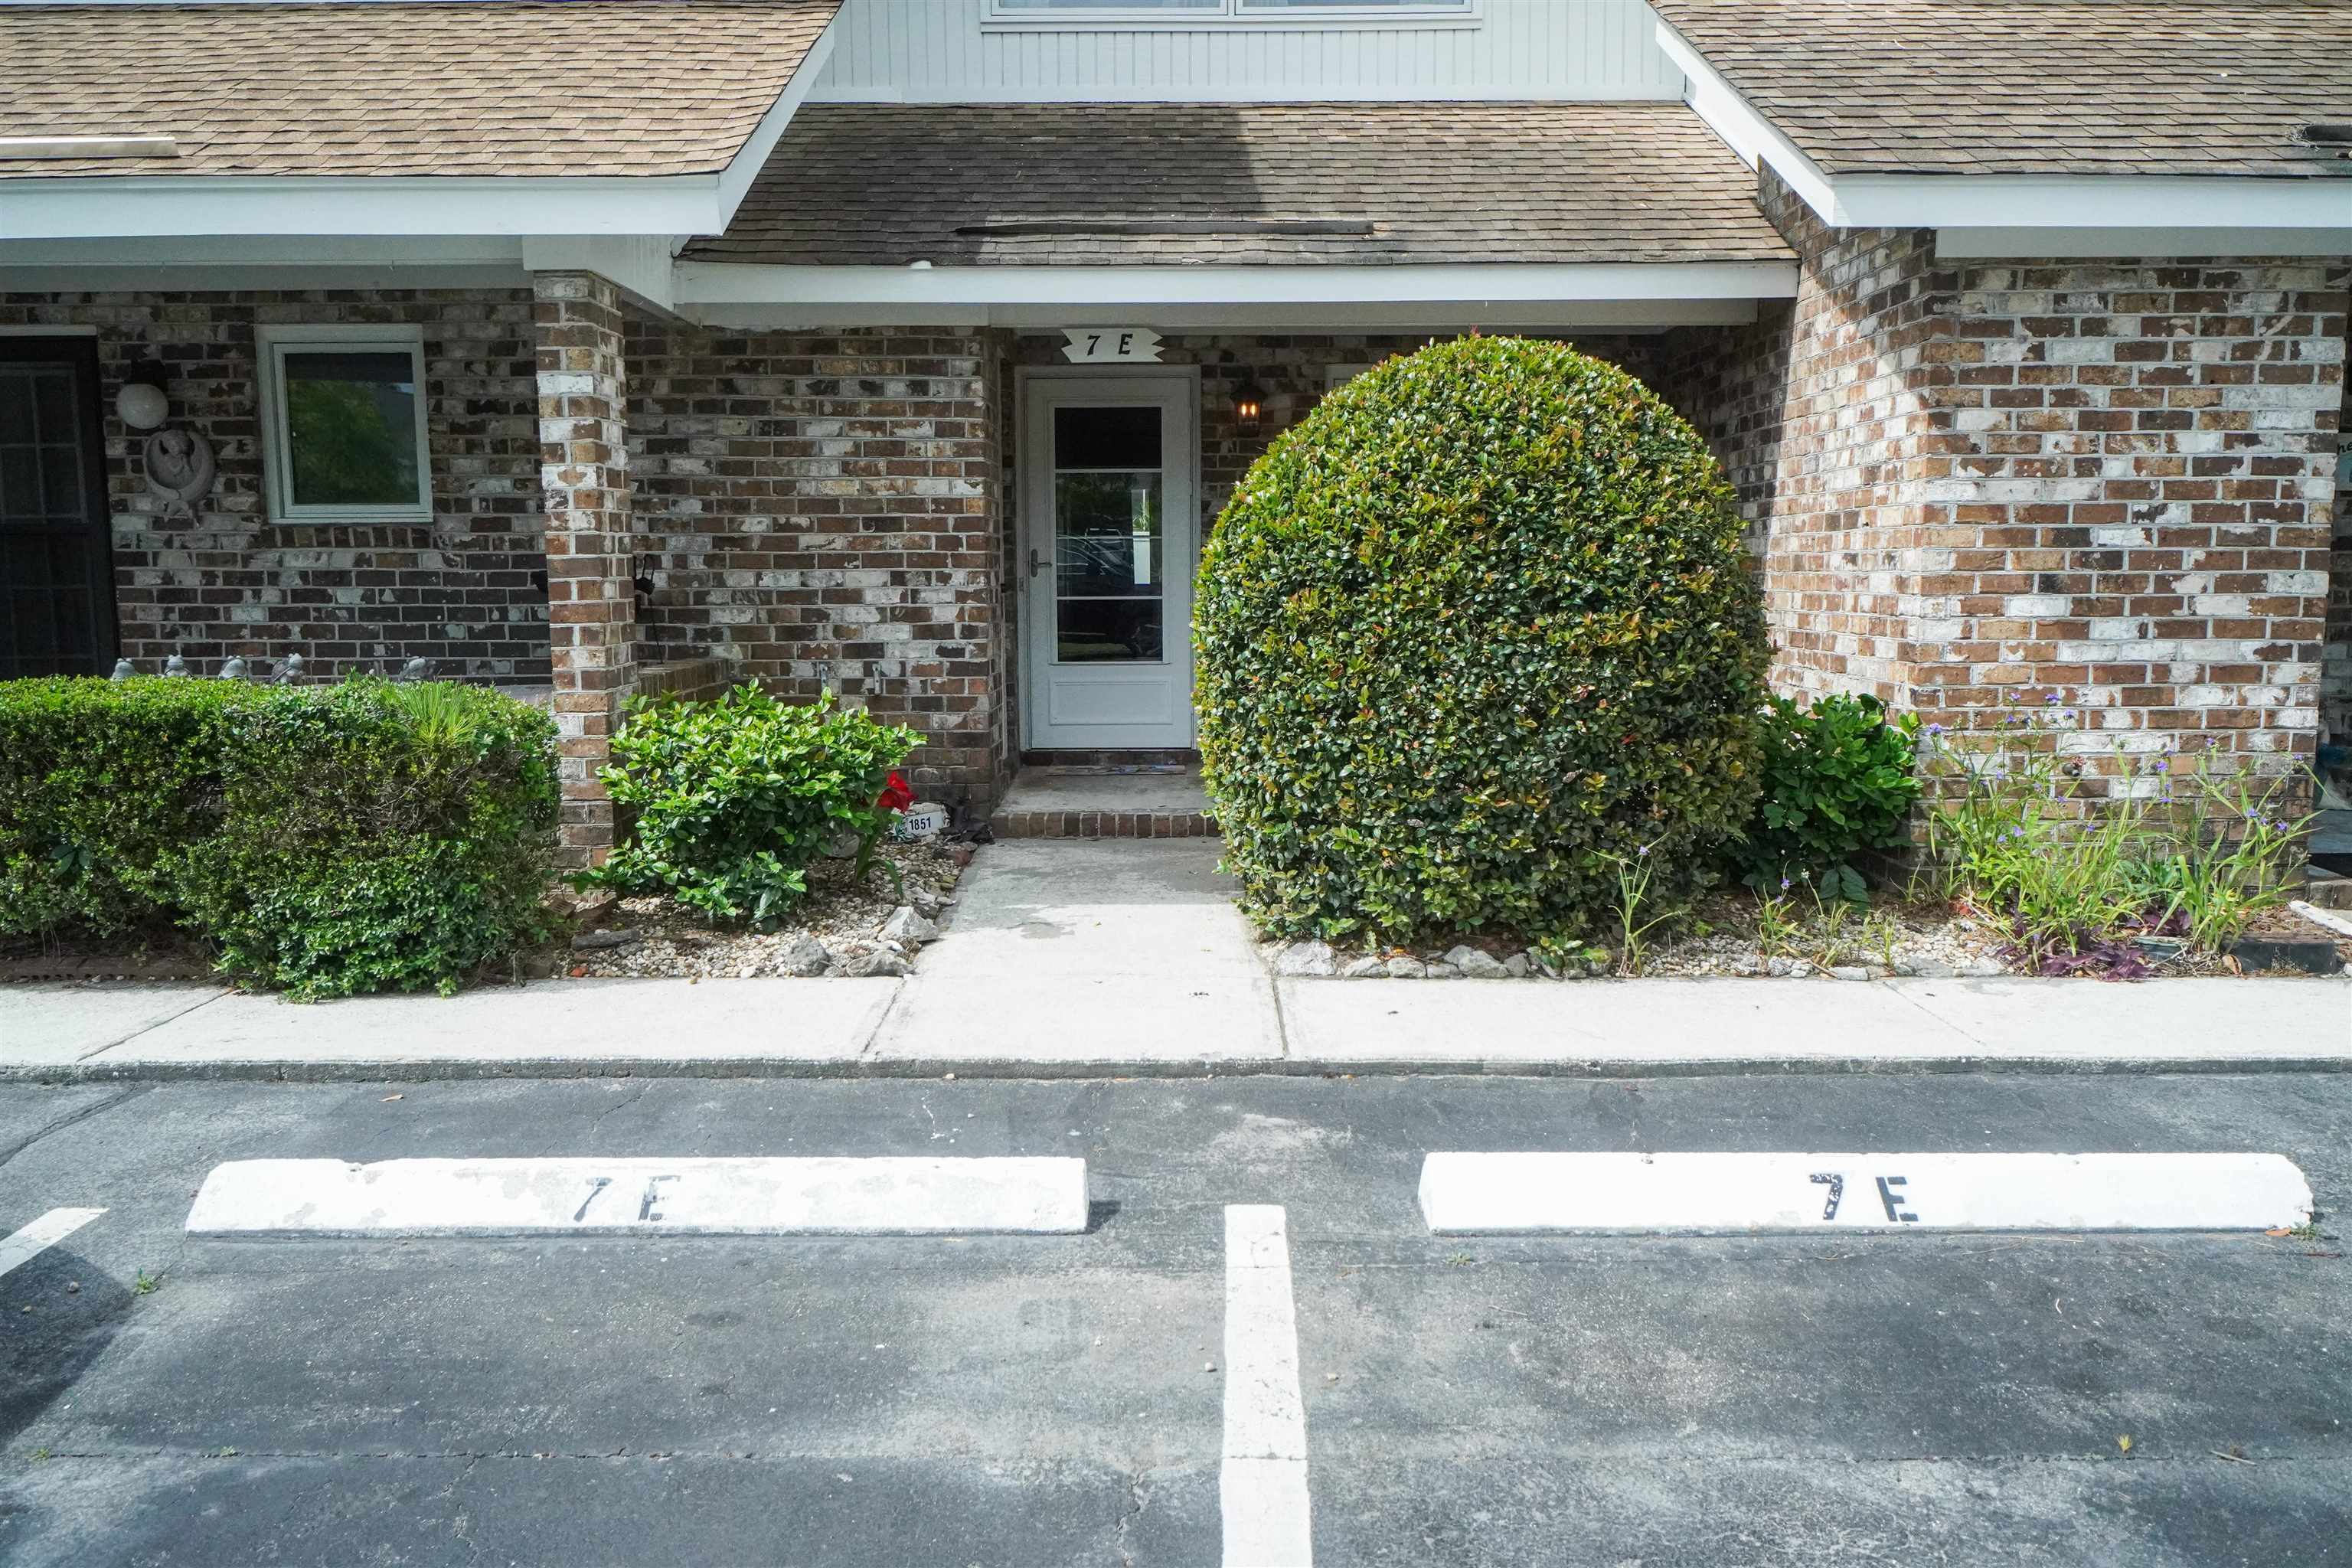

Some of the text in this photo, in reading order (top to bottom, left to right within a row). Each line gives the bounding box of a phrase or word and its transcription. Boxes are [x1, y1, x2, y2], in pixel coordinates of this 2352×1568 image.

[1087, 333, 1134, 356] 7 E
[909, 816, 931, 831] 1851
[573, 1175, 681, 1222] 7 E
[1809, 1174, 1919, 1222] 7 E
